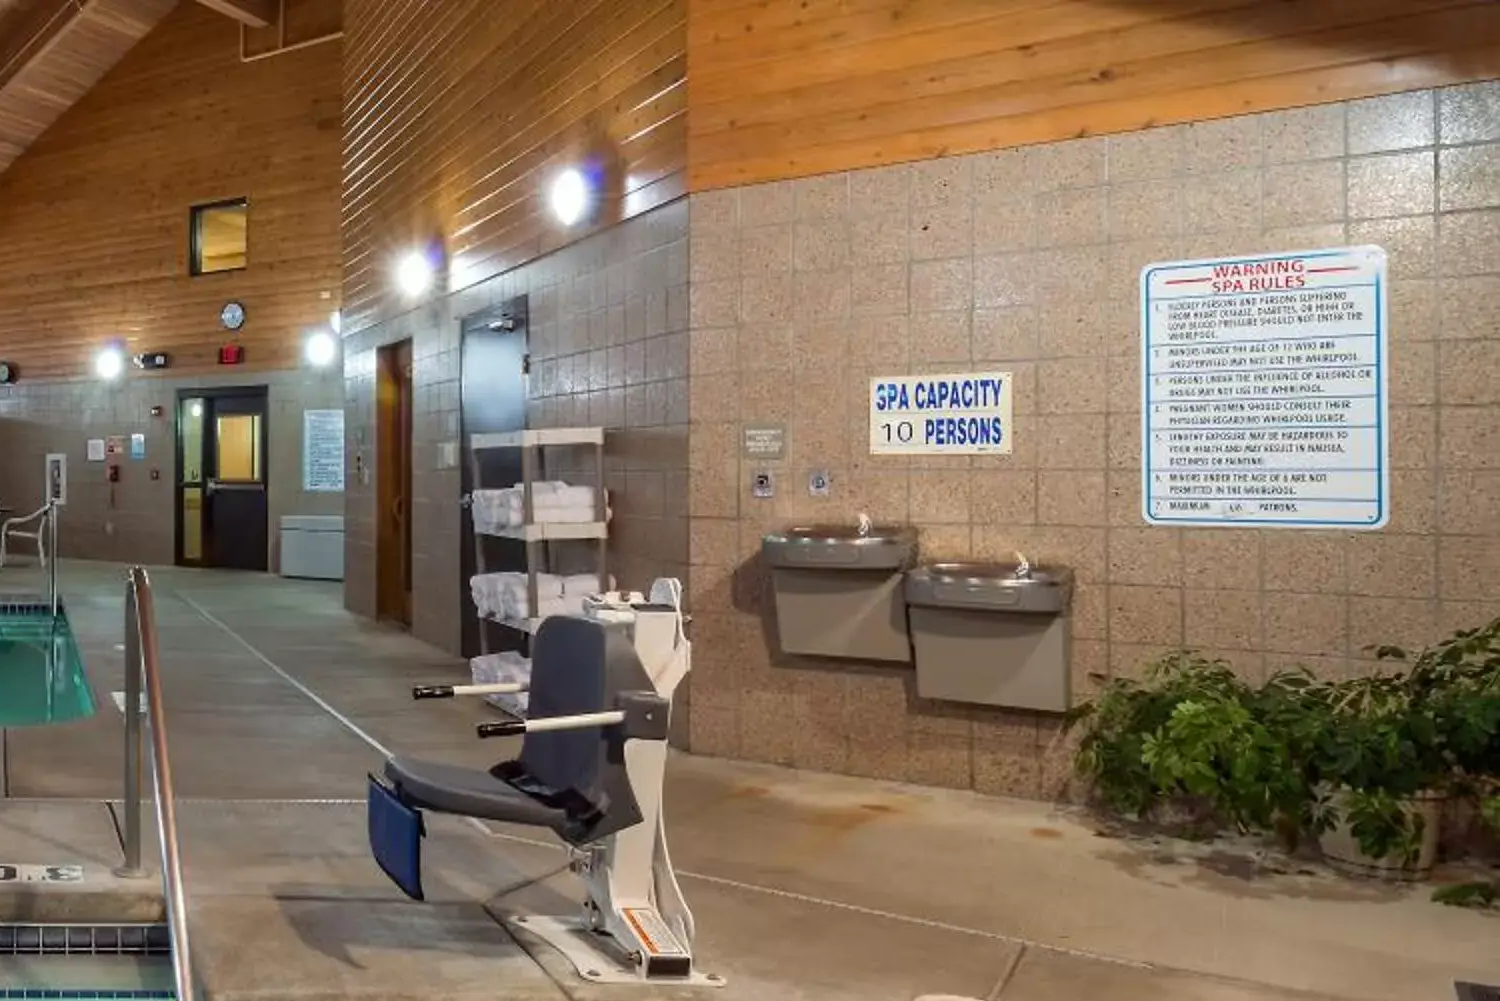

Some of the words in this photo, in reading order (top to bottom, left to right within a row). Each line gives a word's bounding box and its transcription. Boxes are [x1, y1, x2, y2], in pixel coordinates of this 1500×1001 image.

[1214, 261, 1305, 278] WARNING
[1212, 280, 1245, 293] SPA
[1250, 276, 1305, 290] RULES
[876, 383, 909, 411] SPA
[915, 380, 1002, 409] CAPACITY
[881, 421, 913, 443] 10
[925, 417, 1002, 444] PERSONS
